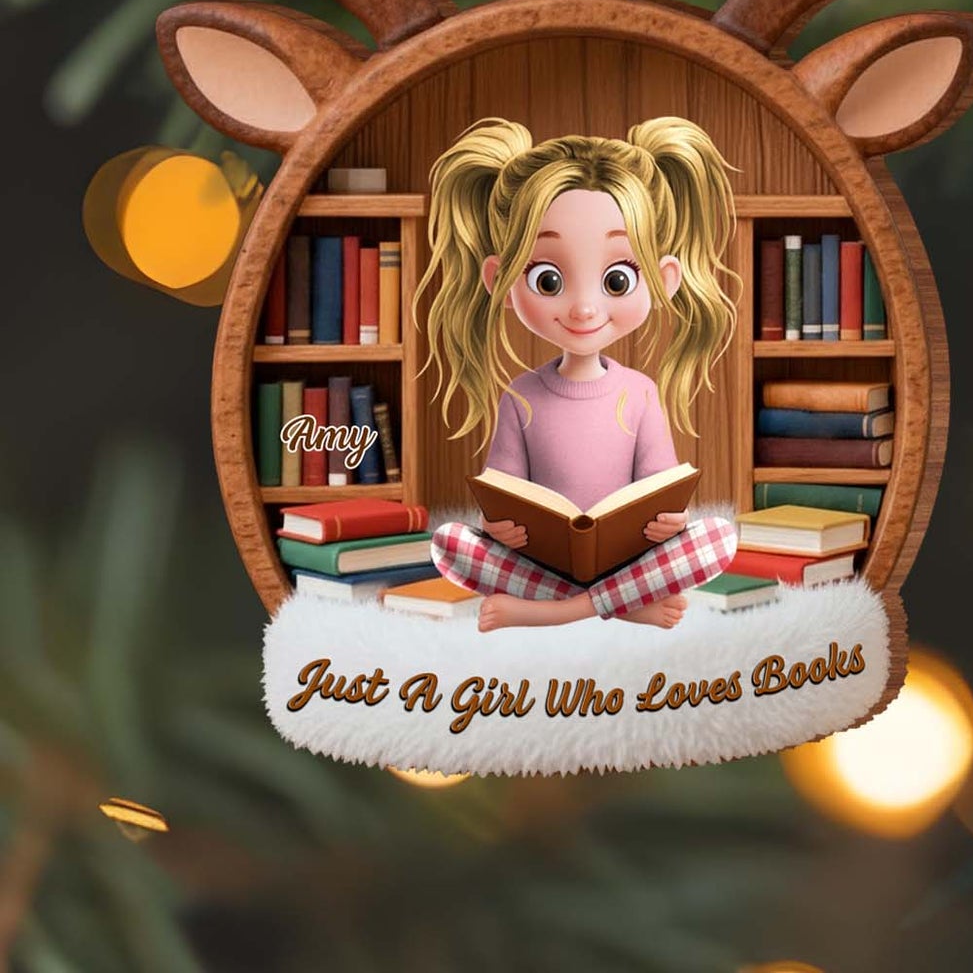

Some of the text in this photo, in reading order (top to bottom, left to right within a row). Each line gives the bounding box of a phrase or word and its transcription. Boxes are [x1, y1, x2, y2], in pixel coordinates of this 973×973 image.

[280, 413, 378, 469] Amy
[287, 642, 866, 733] Just A Girl Who Loves Books
